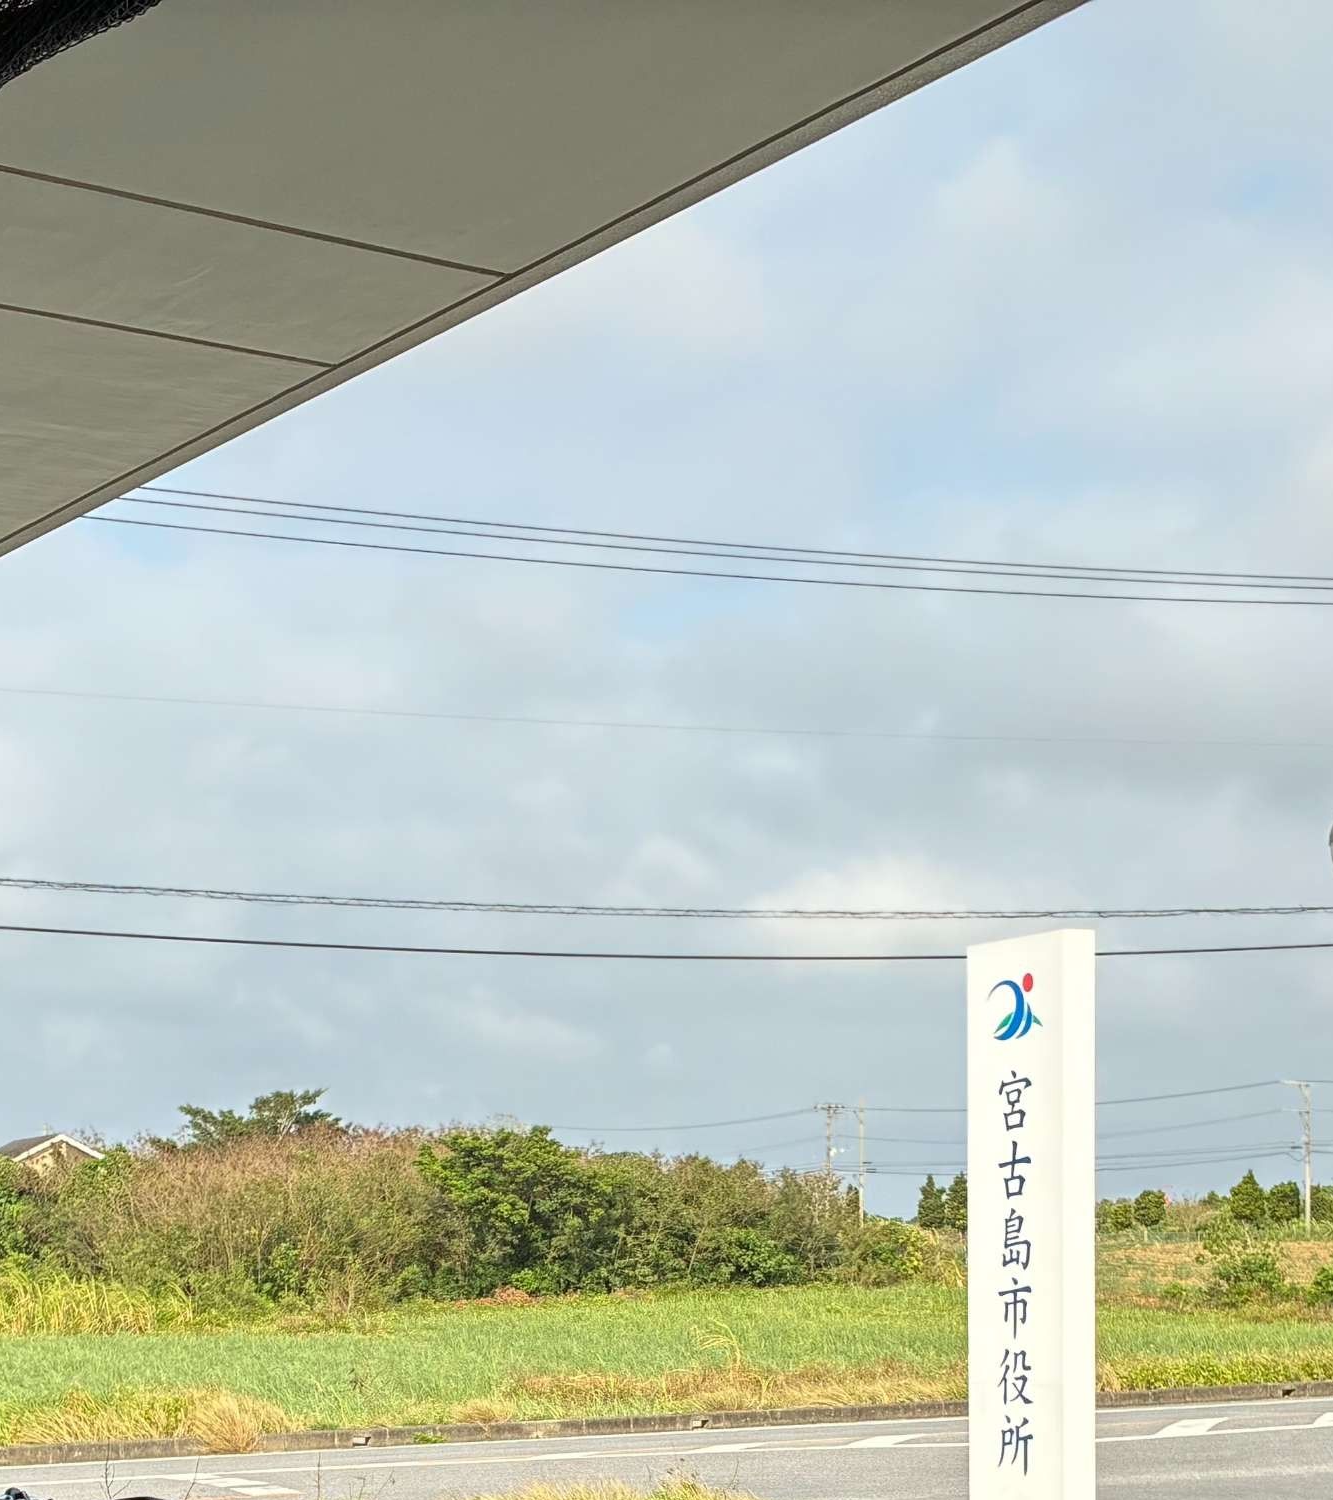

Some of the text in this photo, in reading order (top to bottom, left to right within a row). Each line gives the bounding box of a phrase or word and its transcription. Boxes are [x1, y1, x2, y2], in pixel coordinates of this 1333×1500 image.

[998, 1070, 1034, 1477] 宮古島市役所
